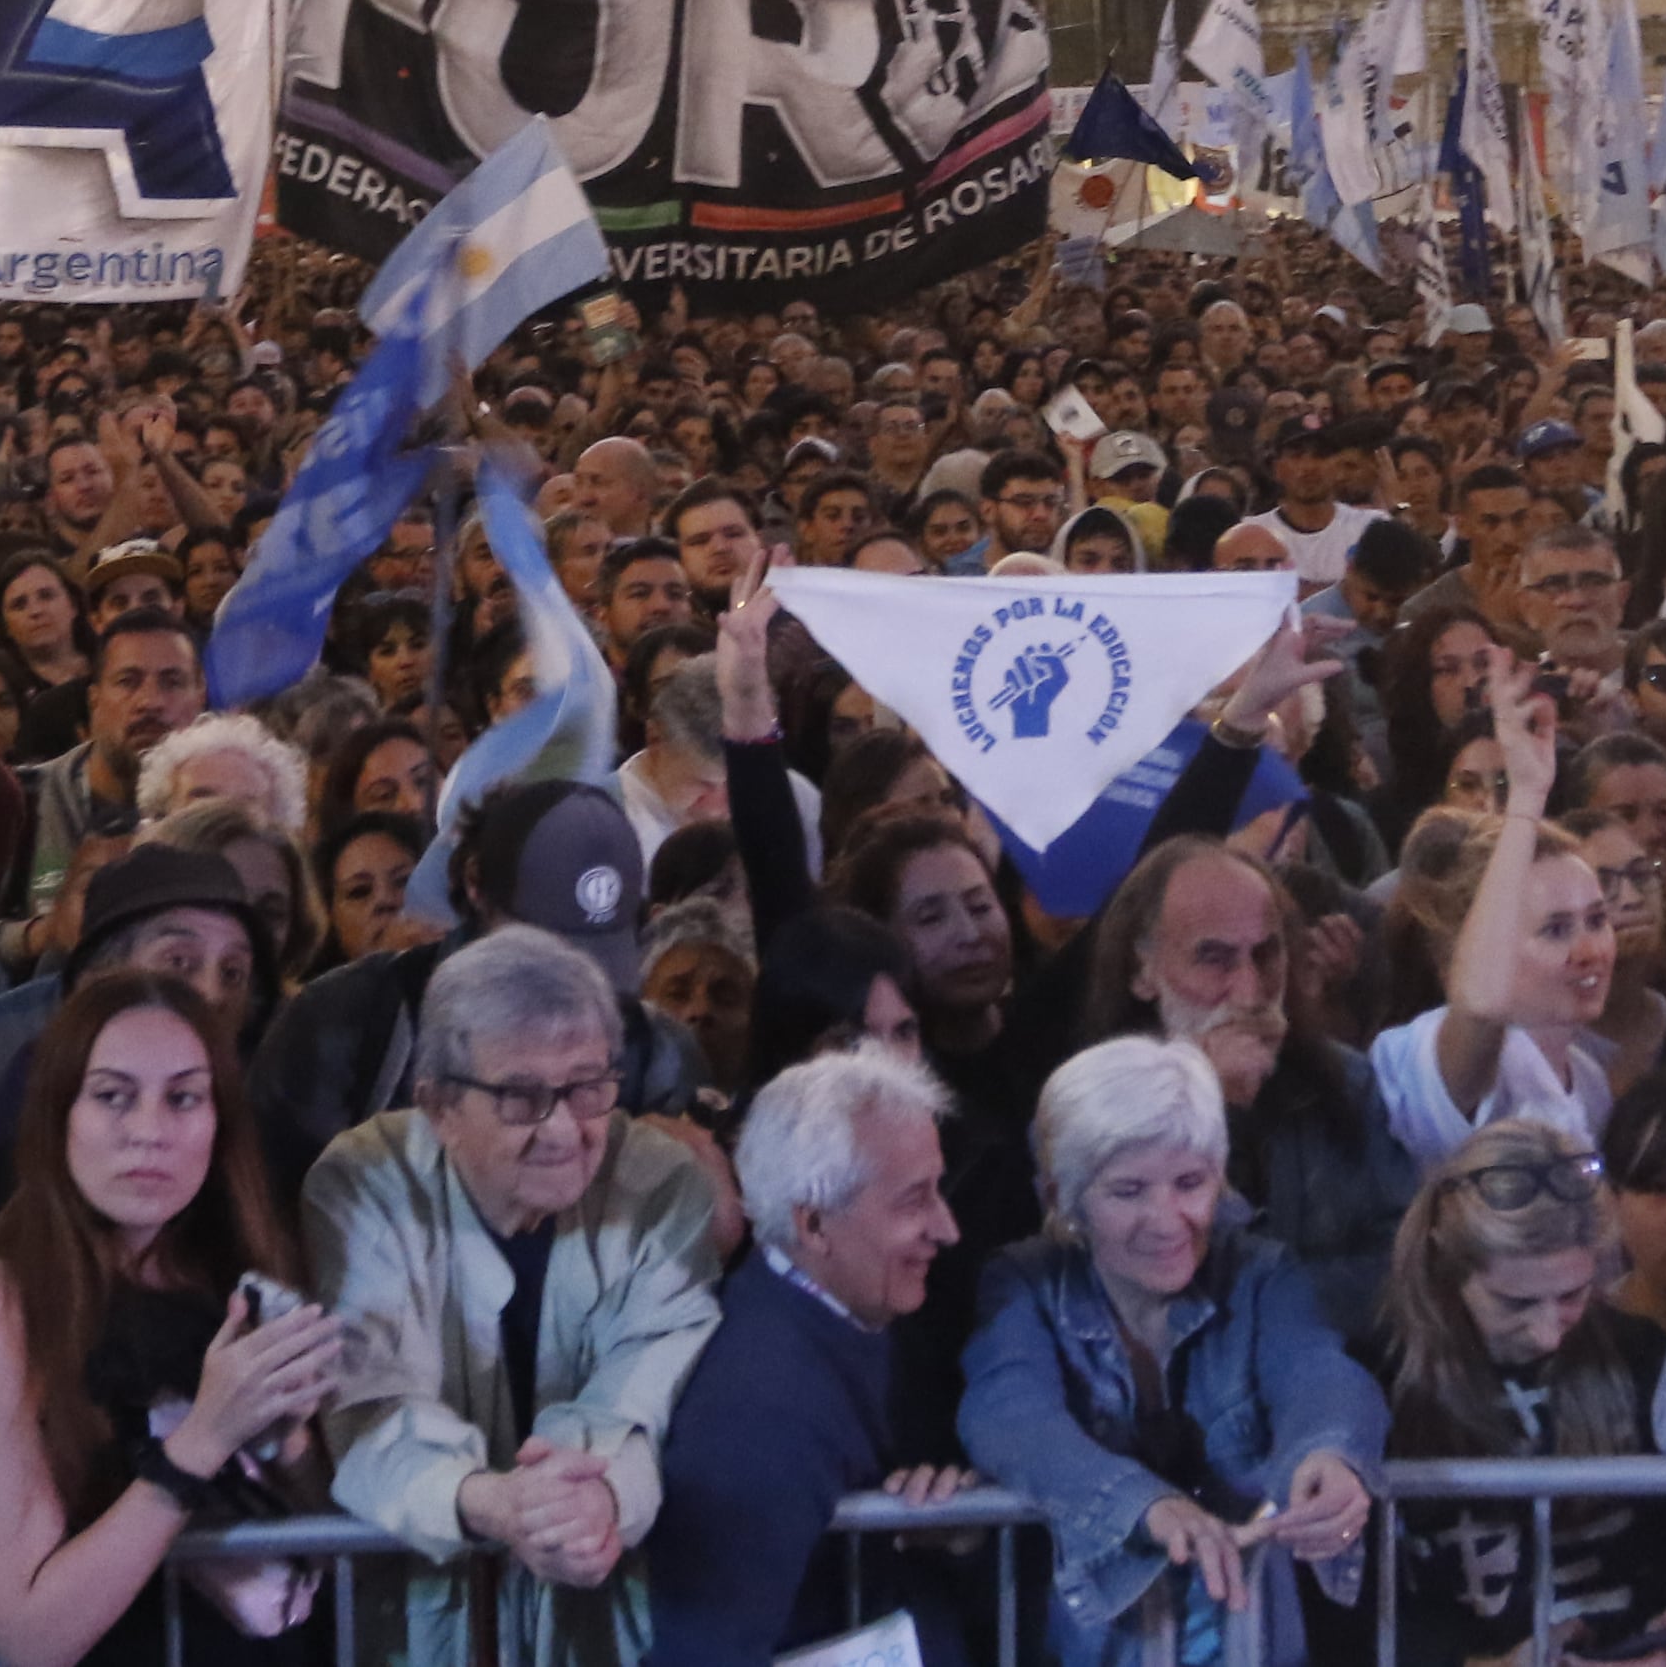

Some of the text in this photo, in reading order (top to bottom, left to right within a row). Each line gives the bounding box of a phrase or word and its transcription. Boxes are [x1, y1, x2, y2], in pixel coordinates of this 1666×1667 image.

[862, 213, 919, 262] DE
[951, 624, 998, 755] LUCHEMOS
[992, 596, 1045, 630] POR
[1053, 596, 1086, 622] LA
